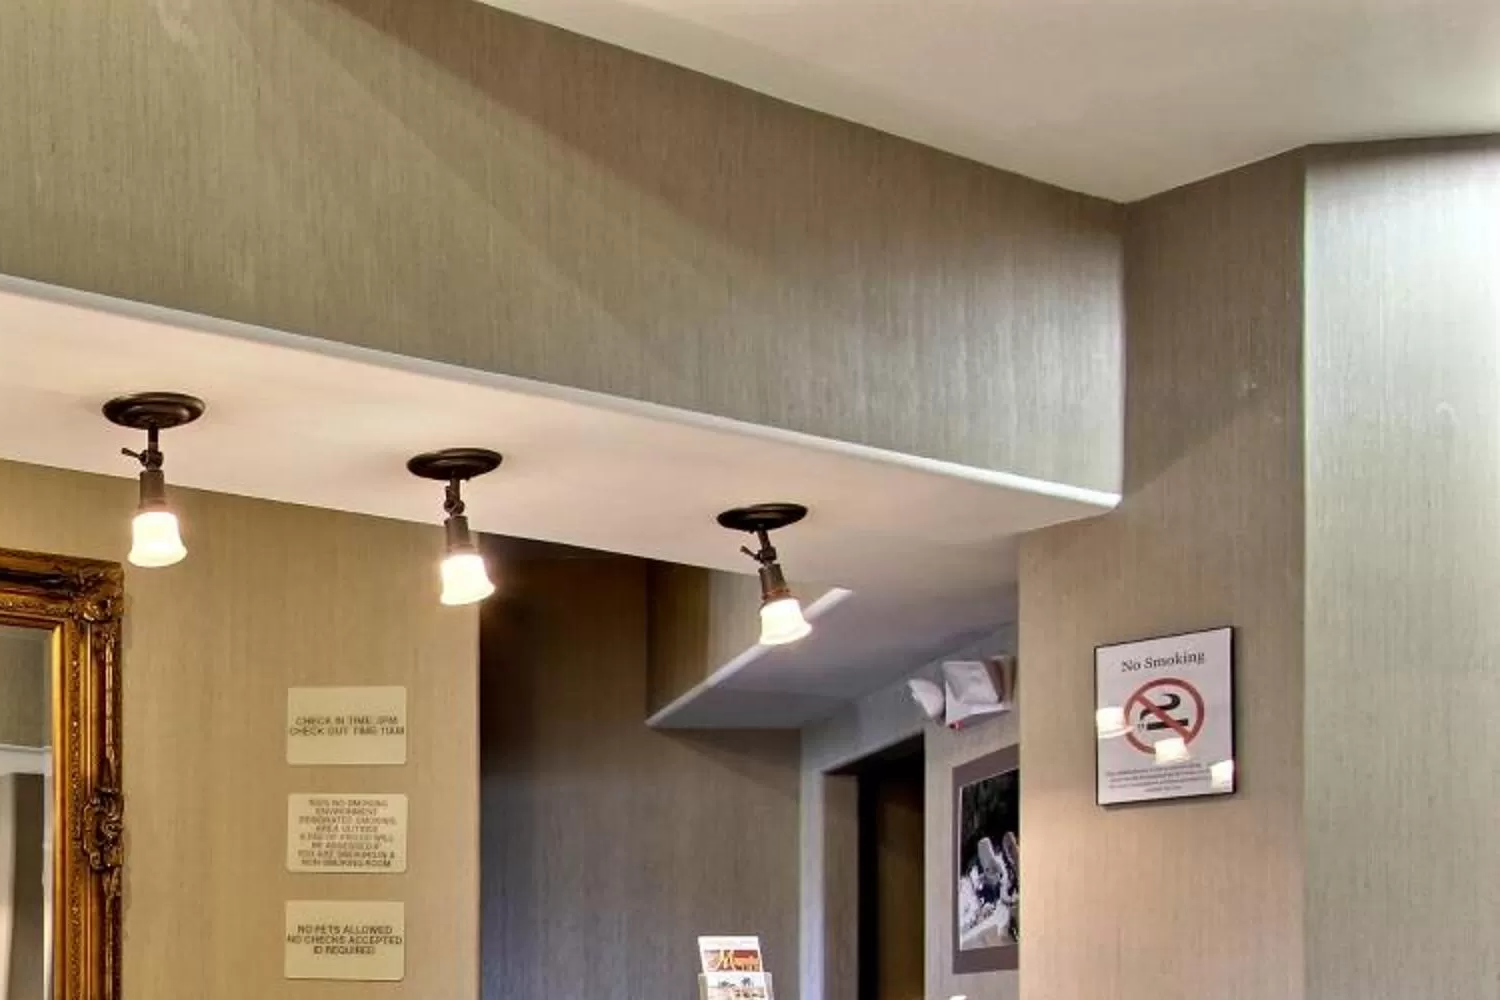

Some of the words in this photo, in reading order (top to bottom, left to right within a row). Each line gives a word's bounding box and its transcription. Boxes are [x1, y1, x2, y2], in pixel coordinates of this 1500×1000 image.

[1121, 660, 1141, 672] No
[1144, 651, 1206, 669] Smoking
[290, 727, 324, 737] CHECK
[328, 727, 348, 737] OUT
[297, 924, 313, 934] NO
[315, 924, 340, 934] PETS
[343, 924, 393, 934] ALLOWED
[287, 934, 302, 944] NO
[304, 935, 347, 944] CHECKS
[348, 935, 403, 944] ACCEPTED
[325, 945, 376, 954] REQUIRED
